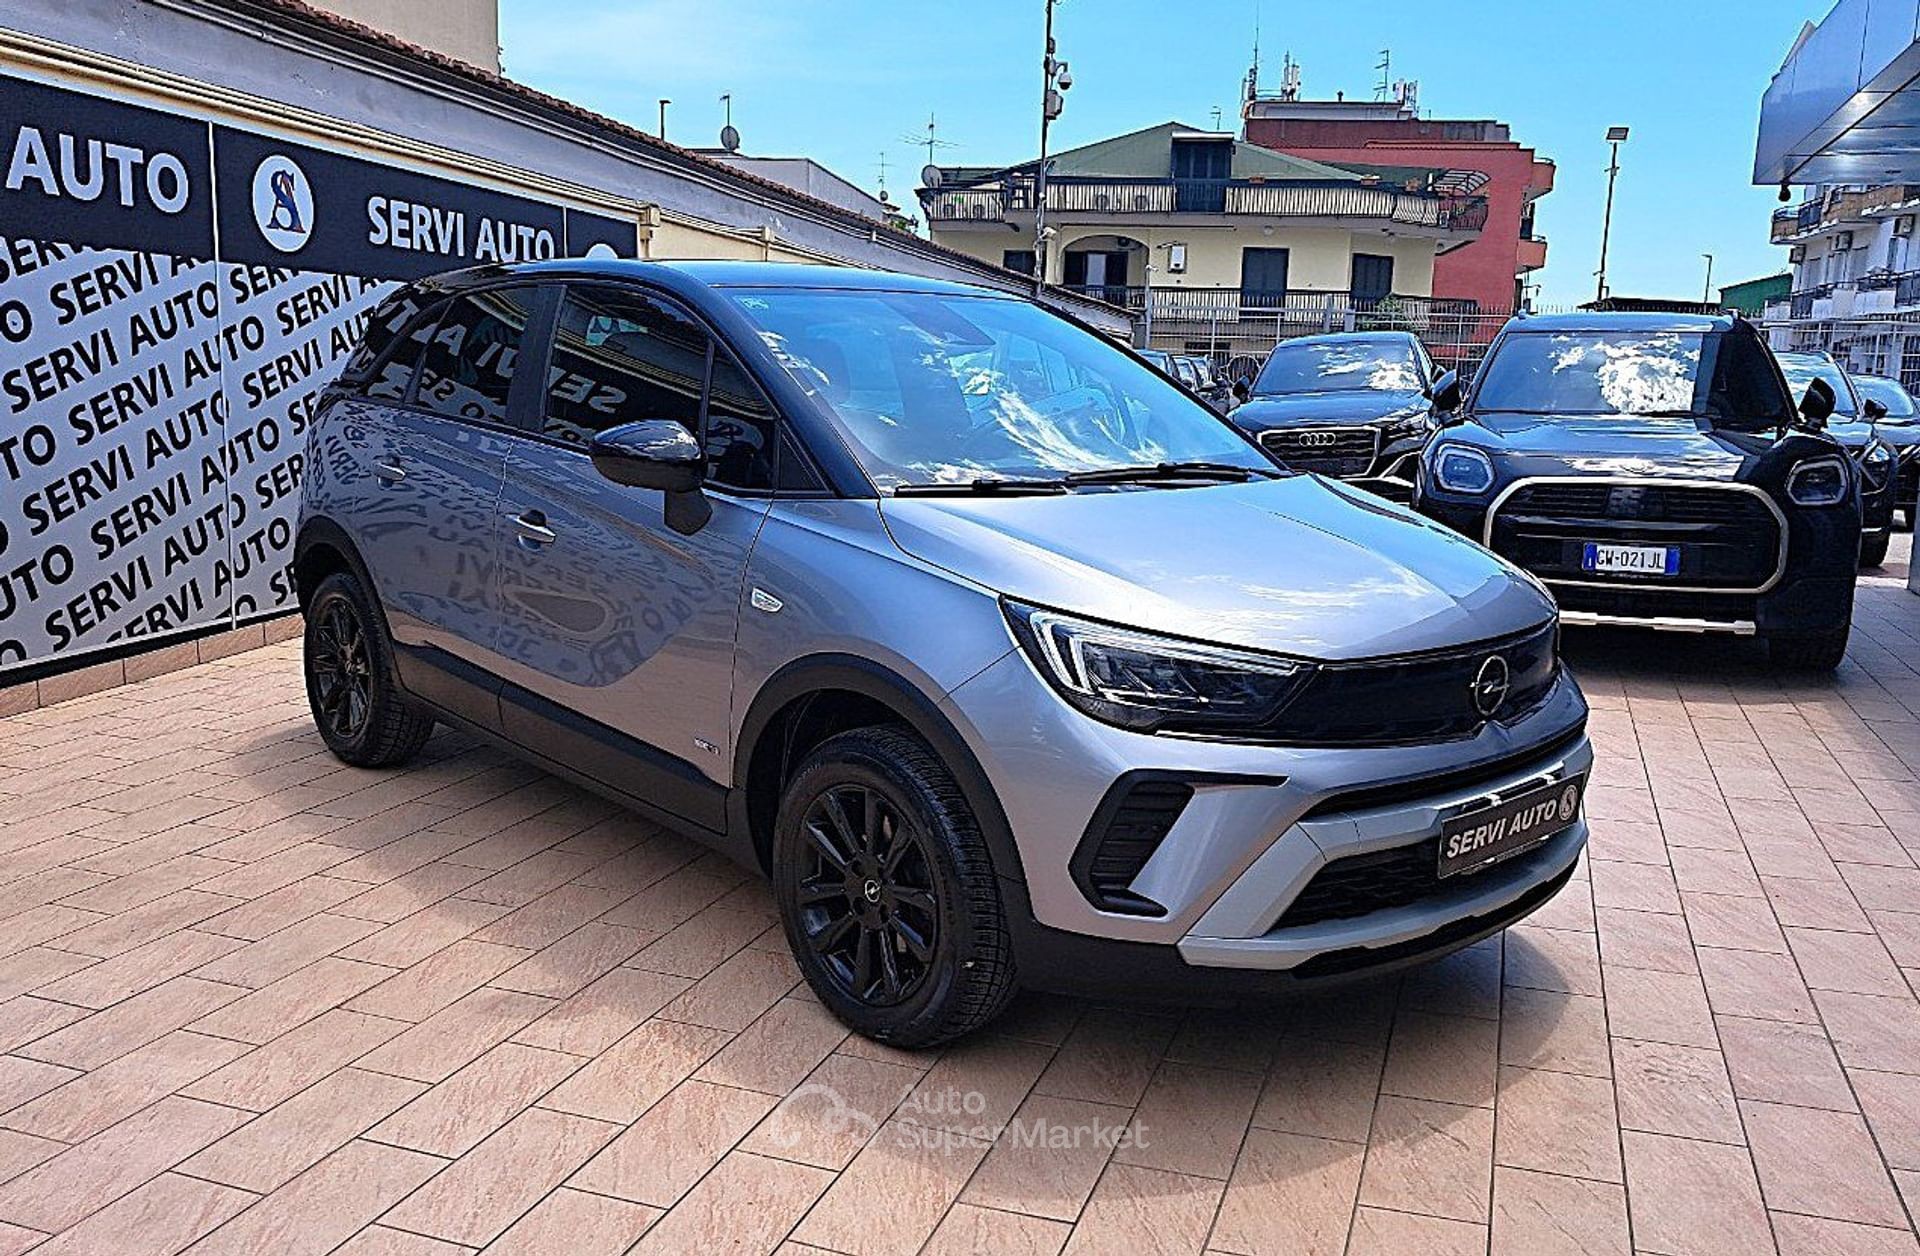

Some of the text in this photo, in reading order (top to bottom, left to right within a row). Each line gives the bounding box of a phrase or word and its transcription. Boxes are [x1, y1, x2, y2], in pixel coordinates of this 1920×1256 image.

[6, 126, 190, 213] AUTO
[368, 196, 555, 263] SERVI AUTO
[50, 252, 159, 325] SERVI
[2, 328, 119, 414] SERVI
[130, 281, 219, 356] AUTO
[68, 363, 174, 446] SERVI
[184, 316, 264, 388] AUTO
[276, 275, 352, 337] SERVI
[23, 444, 135, 536] SERVI
[146, 390, 229, 470] AUTO
[242, 338, 323, 409] SERVI
[91, 472, 192, 561] SERVI
[201, 417, 280, 495] AUTO
[45, 555, 153, 652] SERVI
[214, 517, 290, 598] AUTO
[1447, 818, 1506, 858] SERVI
[1509, 800, 1557, 835] AUTO
